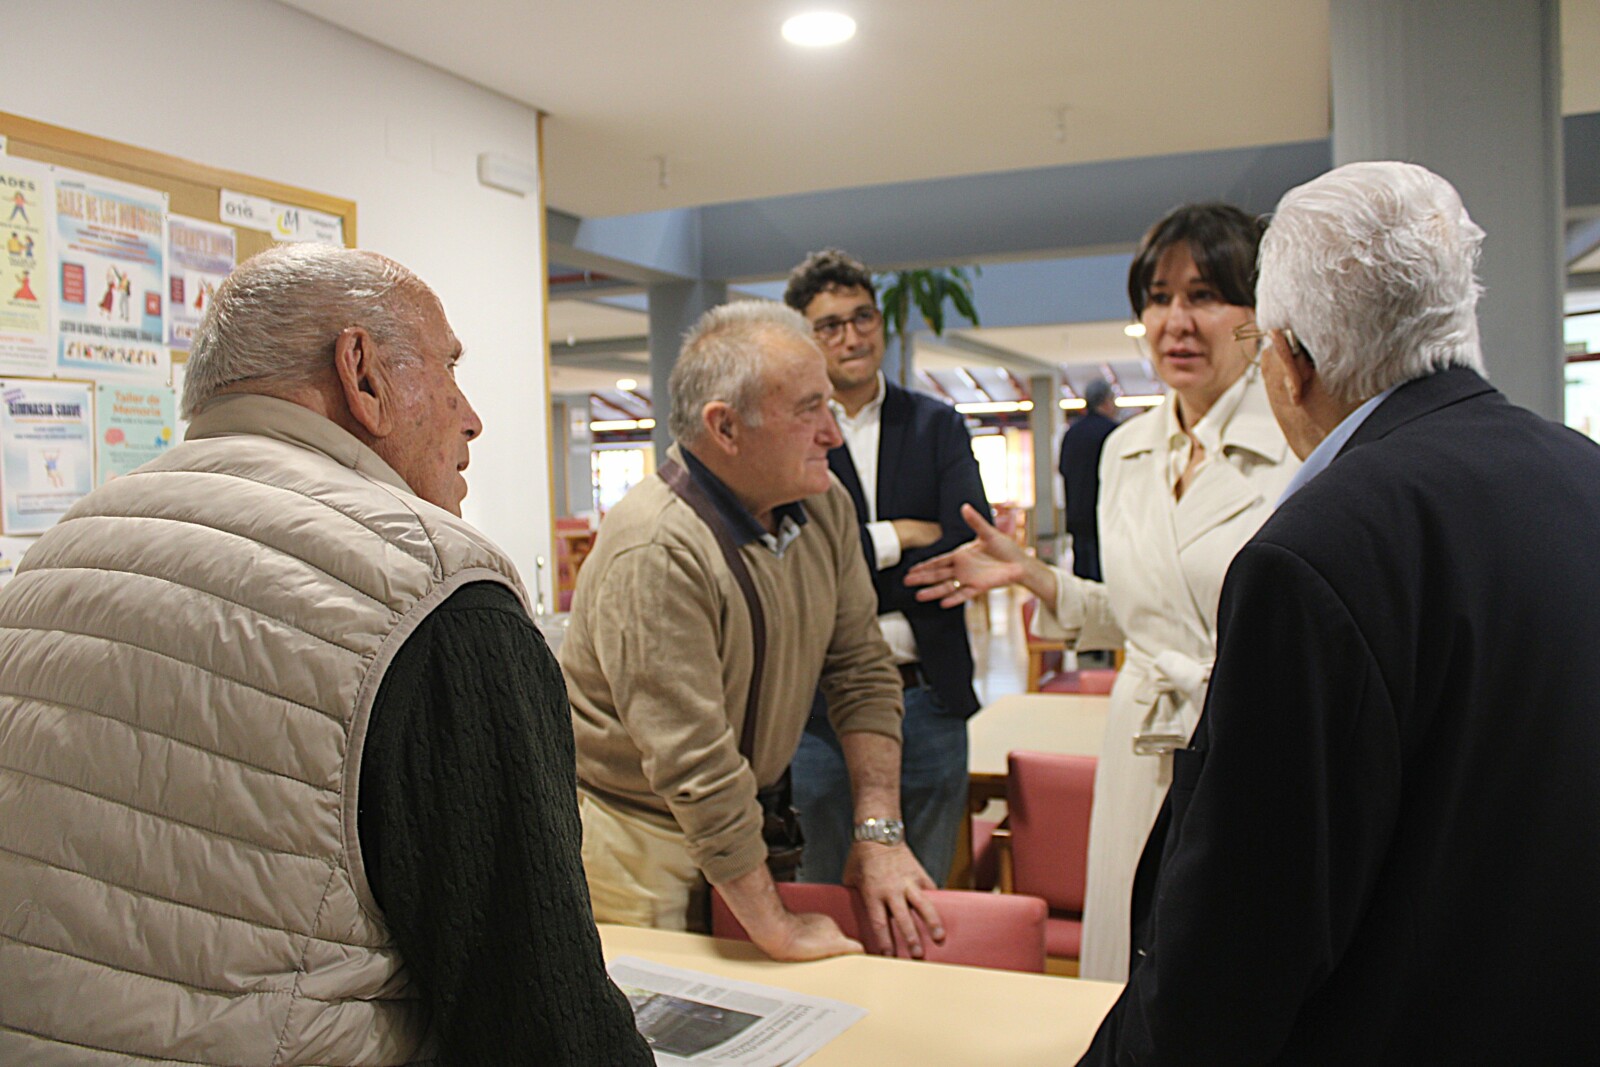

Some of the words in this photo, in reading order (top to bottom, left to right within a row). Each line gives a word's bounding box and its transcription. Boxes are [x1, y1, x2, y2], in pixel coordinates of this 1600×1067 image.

[115, 390, 144, 403] Taller
[146, 393, 160, 405] de
[8, 401, 54, 417] GIMNASIA
[56, 403, 82, 418] SUAVE
[113, 404, 161, 417] Memoria
